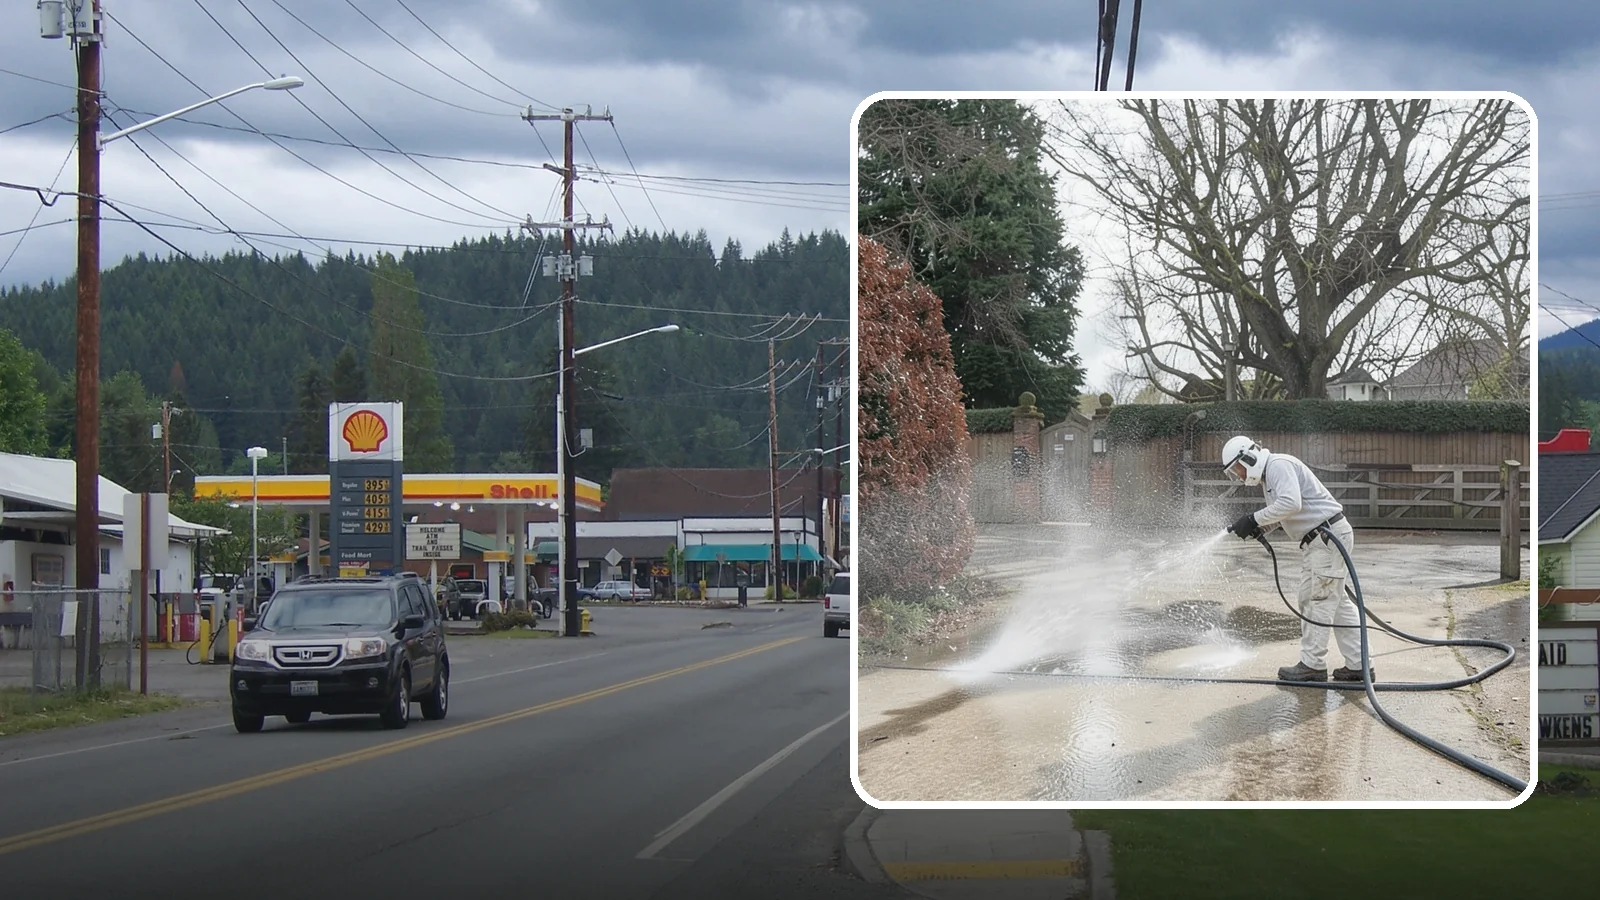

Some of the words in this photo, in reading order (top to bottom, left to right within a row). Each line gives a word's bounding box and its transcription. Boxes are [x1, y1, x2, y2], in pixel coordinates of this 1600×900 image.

[366, 480, 383, 490] 395
[490, 484, 547, 499] Shell
[366, 494, 383, 504] 405
[366, 508, 383, 517] 415
[366, 522, 383, 532] 429
